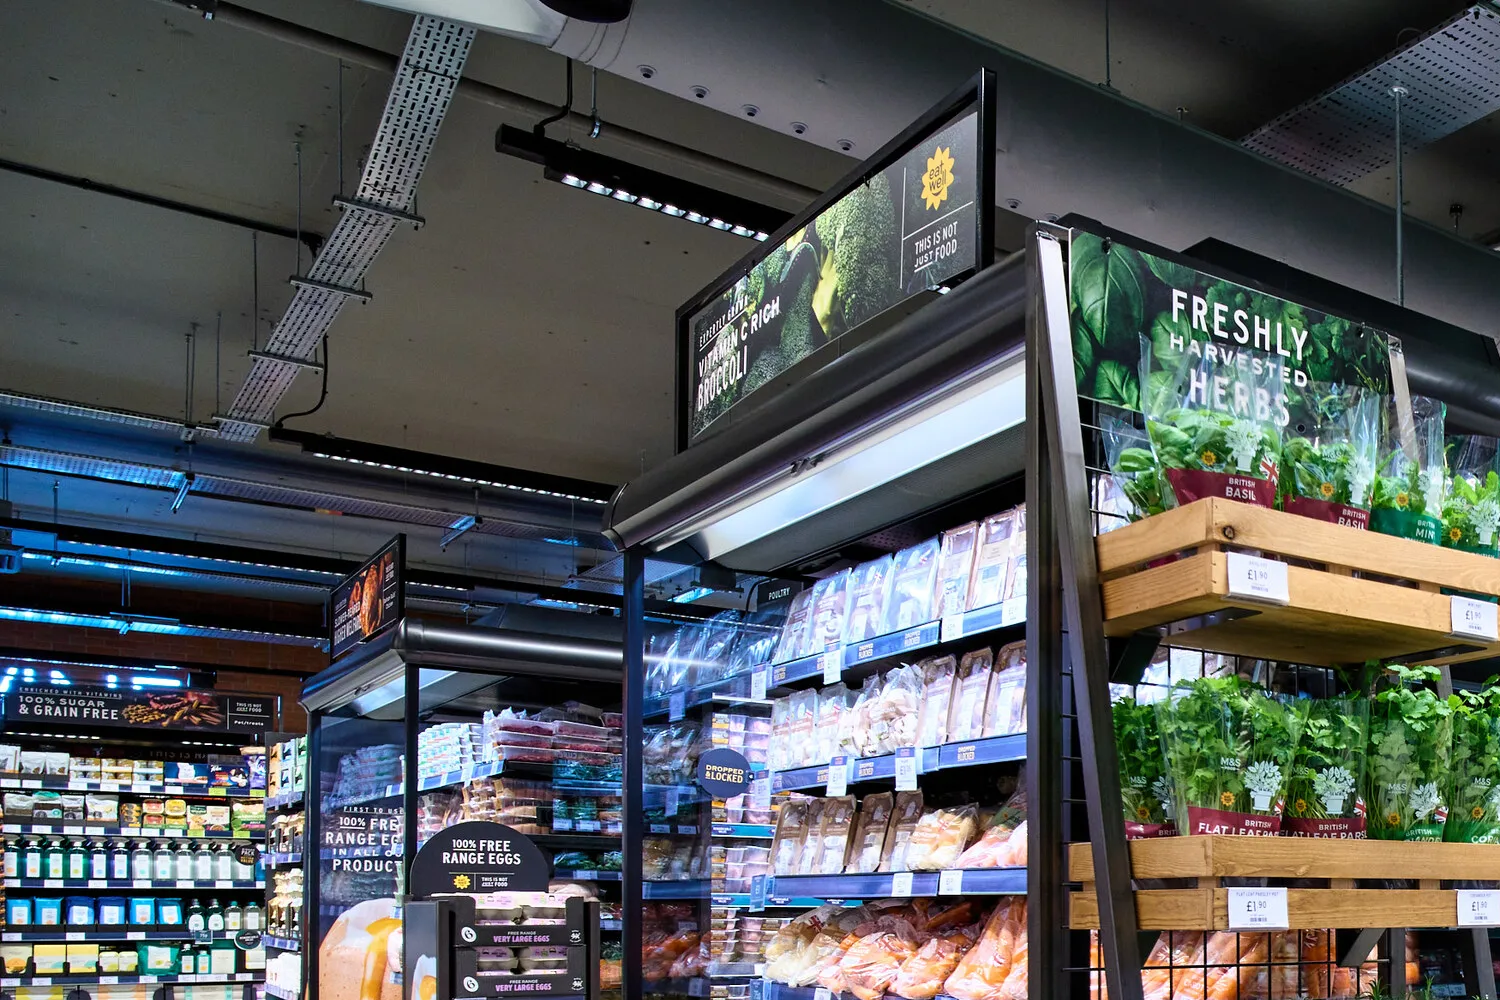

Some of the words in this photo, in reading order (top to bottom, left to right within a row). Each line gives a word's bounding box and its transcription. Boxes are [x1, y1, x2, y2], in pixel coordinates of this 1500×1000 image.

[929, 160, 944, 180] eat
[929, 169, 947, 192] well
[915, 235, 931, 255] THIS
[933, 229, 940, 246] IS
[942, 221, 958, 240] NOT
[914, 251, 933, 267] JUST
[935, 239, 957, 262] FOOD
[700, 315, 726, 347] EXPERTLY
[1172, 289, 1308, 361] FRESHLY
[699, 329, 738, 377] VITAMIN
[741, 321, 748, 341] C
[751, 296, 780, 334] RICH
[1170, 333, 1308, 388] HARVESTED
[698, 345, 747, 412] BROCCOLI
[1189, 368, 1290, 427] HERBS
[1228, 477, 1256, 488] BRITISH
[1225, 486, 1257, 501] BASIL
[1342, 508, 1366, 520] BRITISH
[769, 587, 790, 600] POULTRY
[19, 696, 55, 704] 100%
[60, 698, 105, 707] SUGAR
[19, 704, 29, 714] &
[34, 705, 78, 717] GRAIN
[83, 707, 118, 719] FREE
[1221, 757, 1241, 767] M&S
[706, 765, 744, 775] DROPPED
[1131, 776, 1147, 784] M&S
[1474, 777, 1491, 786] M&S
[1388, 783, 1407, 791] M&S
[340, 817, 365, 826] 100%
[1245, 819, 1272, 828] BRITISH
[1199, 823, 1229, 835] FLAT
[326, 832, 376, 845] RANGE
[453, 840, 476, 848] 100%
[480, 840, 510, 851] FREE
[443, 852, 485, 864] RANGE
[488, 853, 521, 865] EGGS
[1247, 901, 1267, 912] £1.90
[465, 929, 473, 938] 6
[493, 935, 510, 943] VERY
[512, 935, 532, 943] LARGE
[467, 979, 475, 989] 6
